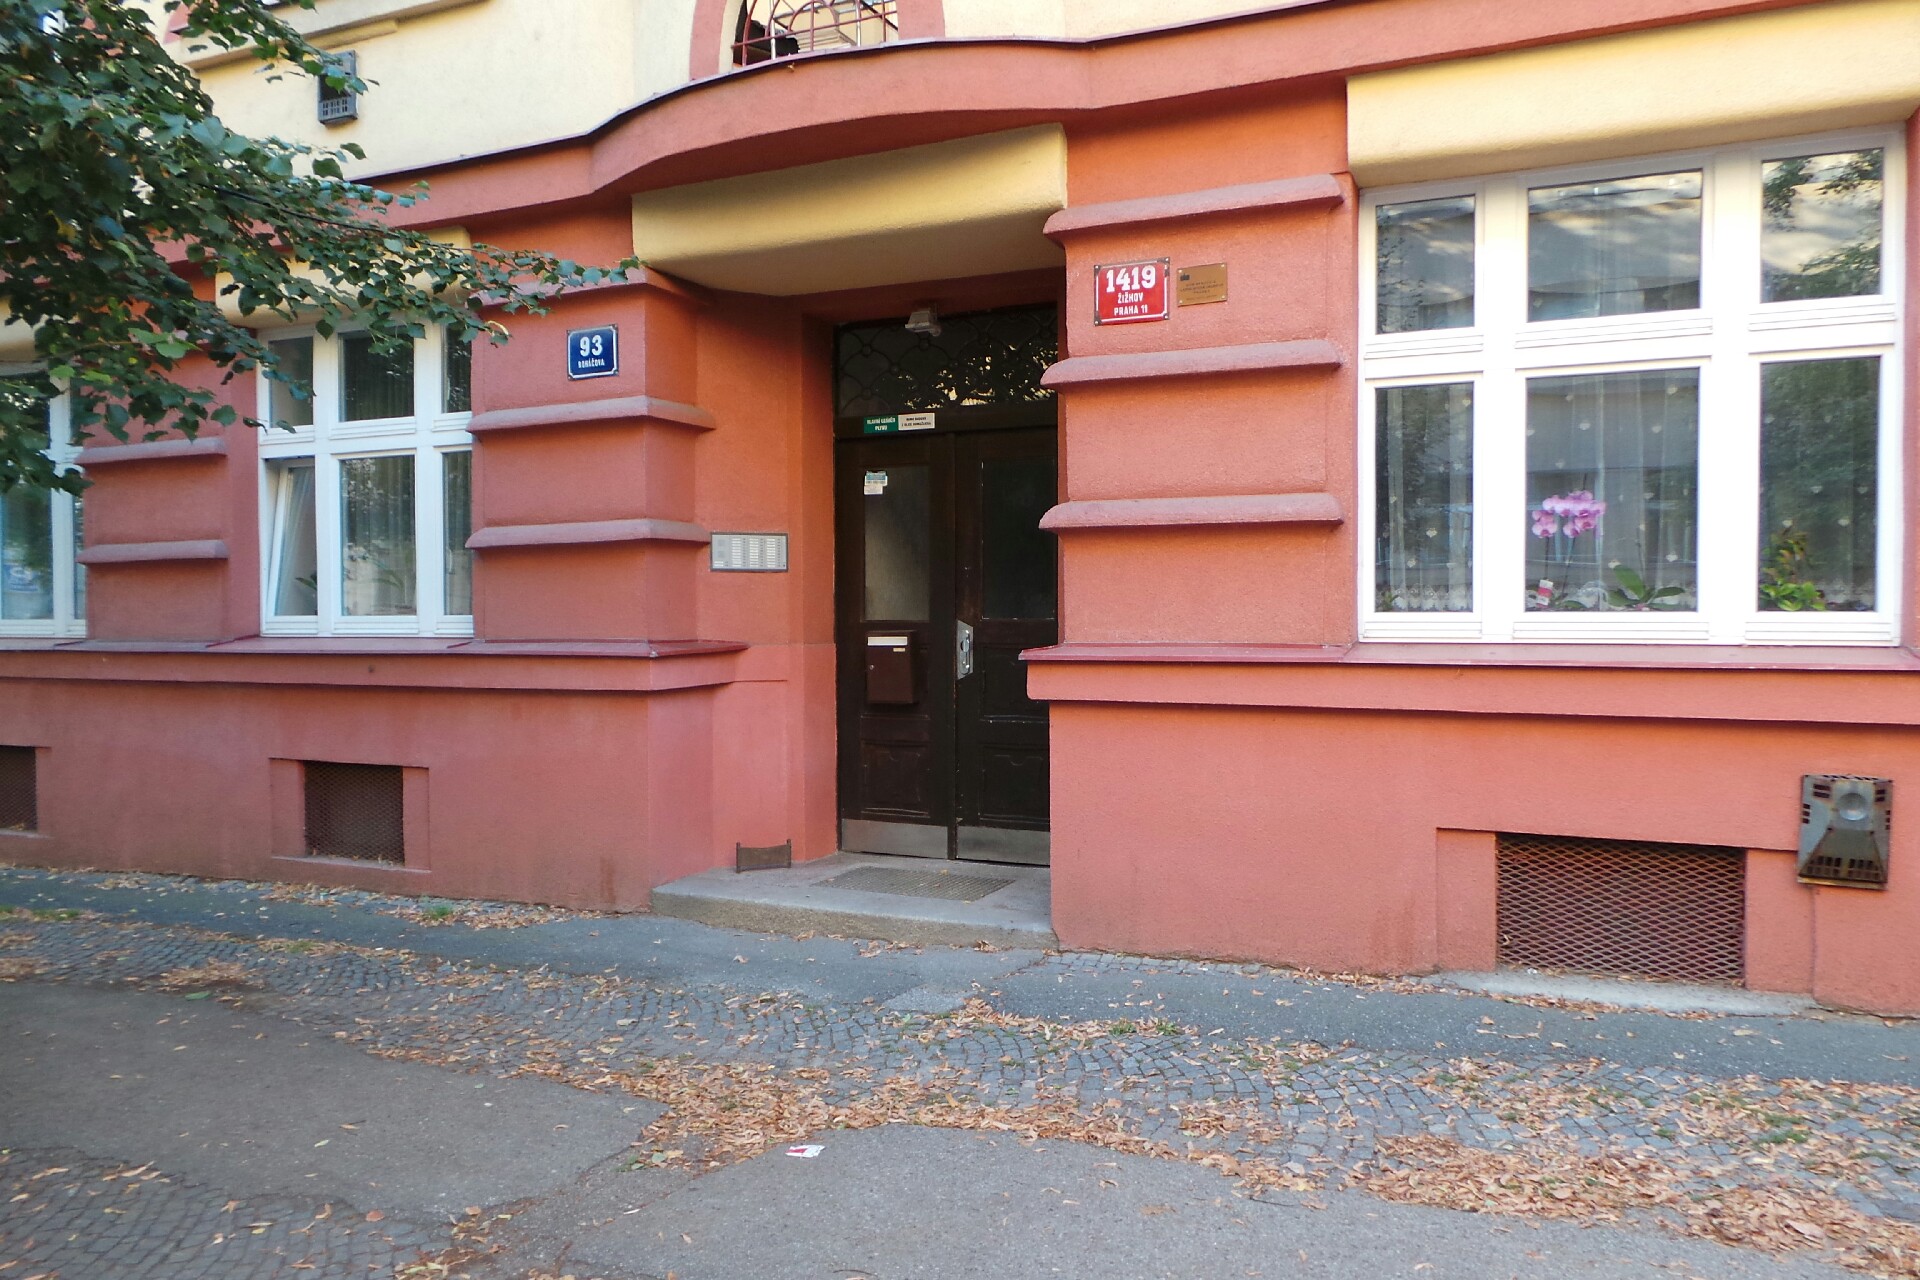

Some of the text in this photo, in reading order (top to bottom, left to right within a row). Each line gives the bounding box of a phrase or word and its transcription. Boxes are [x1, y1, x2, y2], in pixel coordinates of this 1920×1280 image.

[1106, 265, 1156, 292] 1419
[1118, 292, 1144, 304] ŽIŽKOV
[1114, 304, 1148, 316] PRAHA 11
[580, 334, 603, 356] 93
